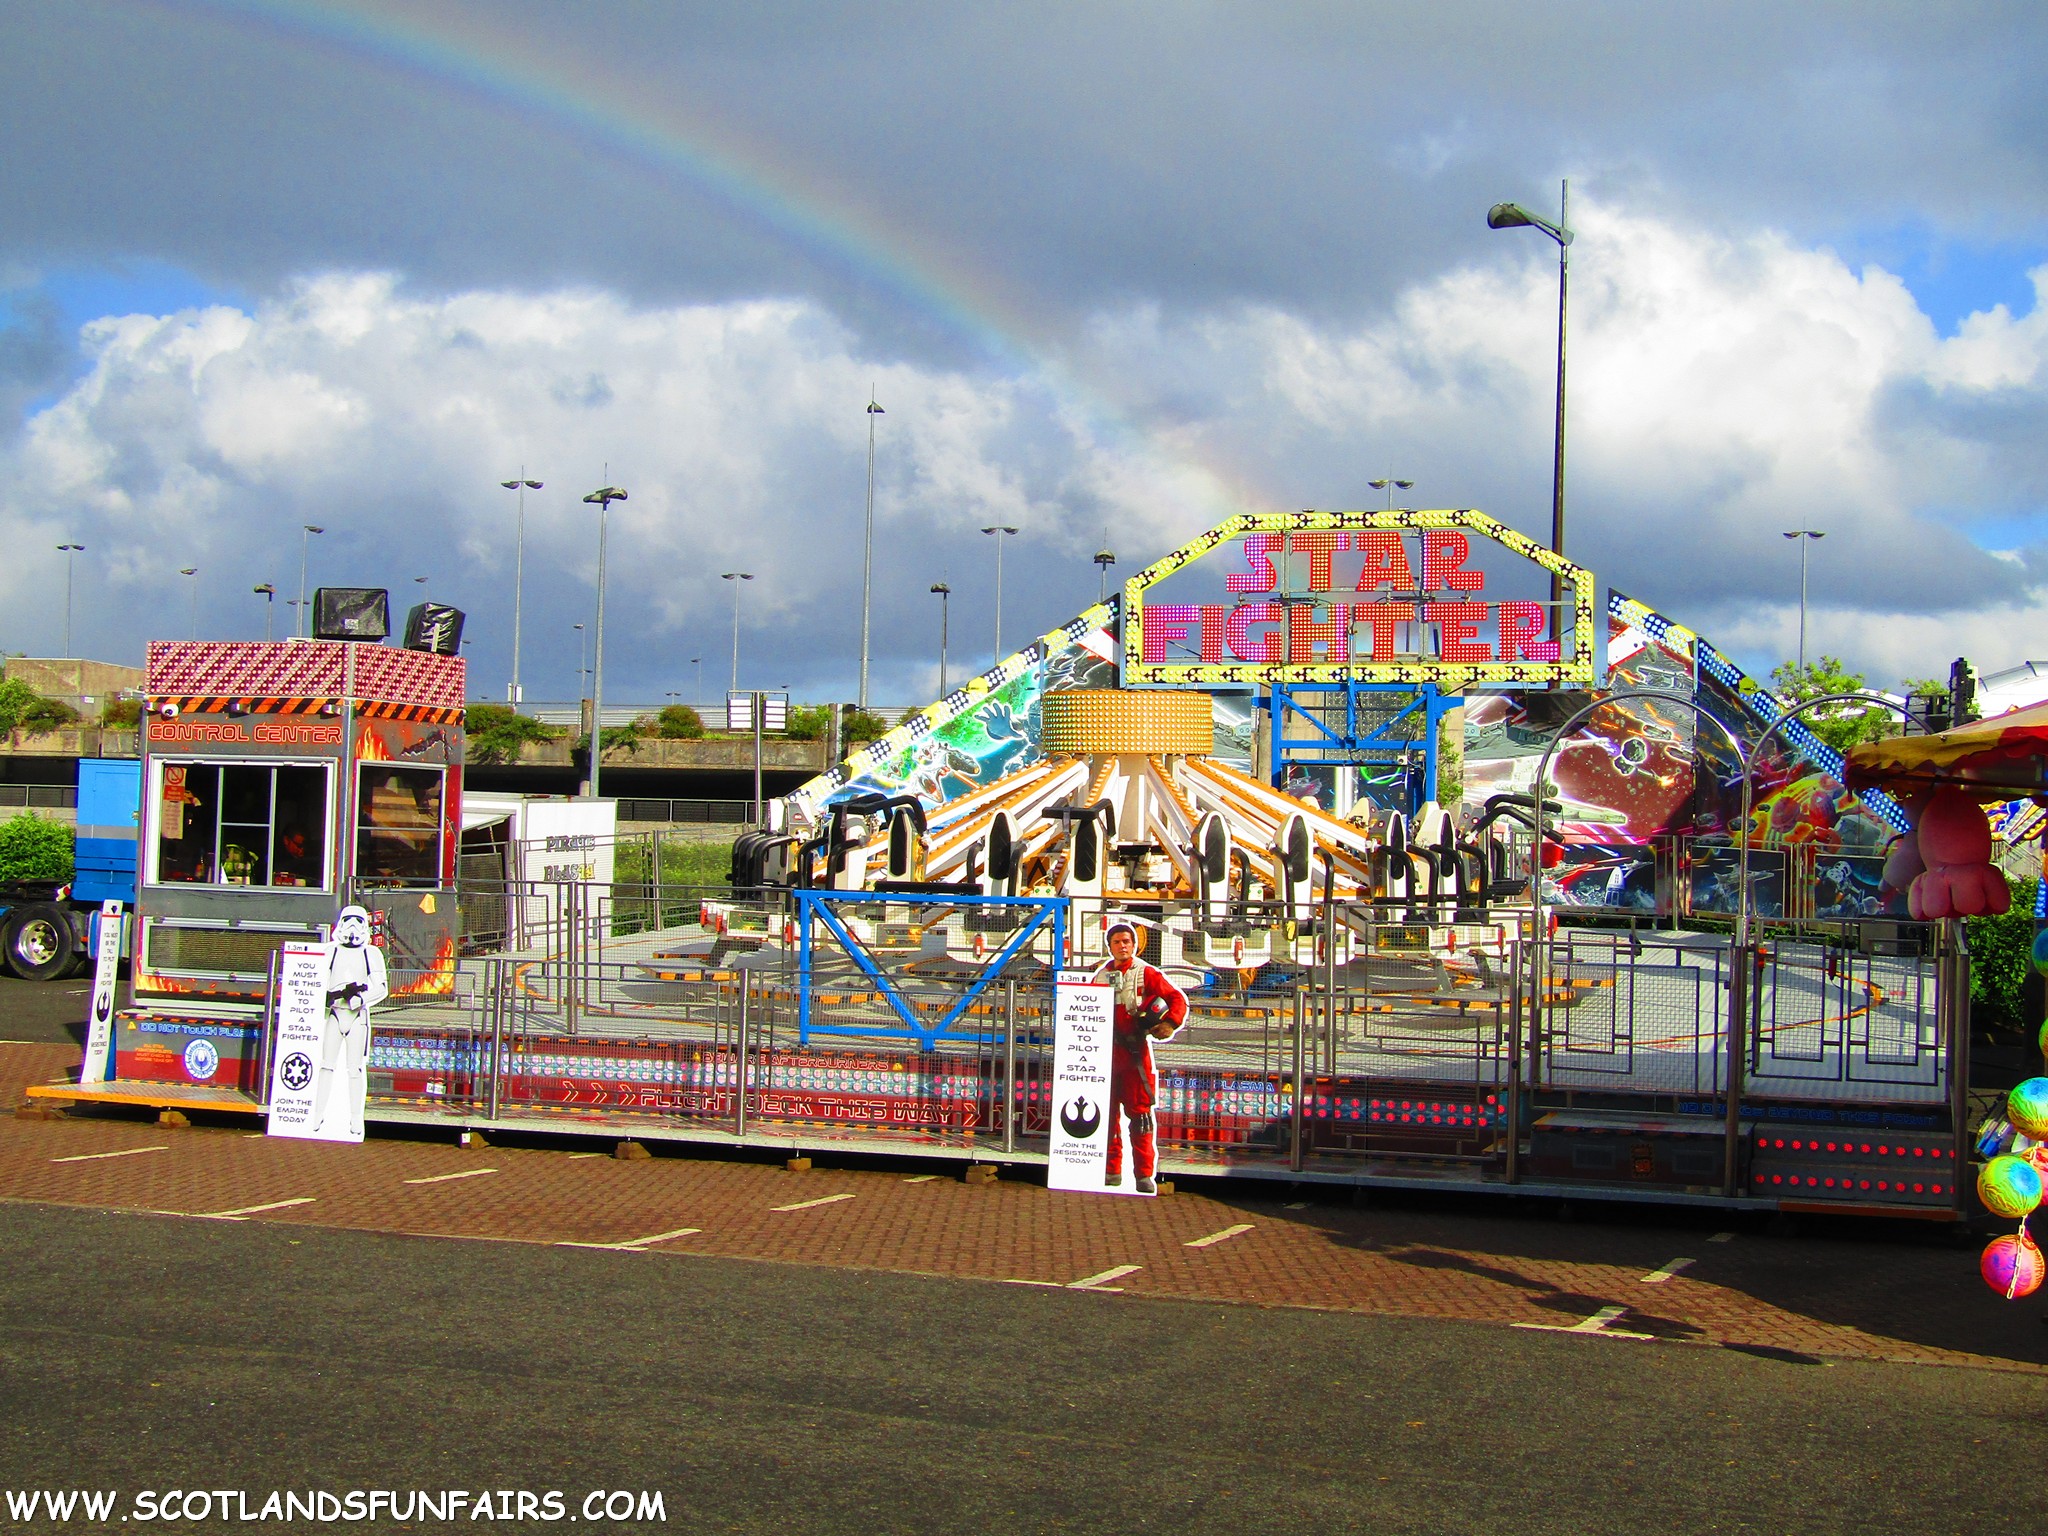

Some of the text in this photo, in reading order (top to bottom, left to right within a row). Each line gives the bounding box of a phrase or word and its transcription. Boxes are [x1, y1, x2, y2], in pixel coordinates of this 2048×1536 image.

[1226, 531, 1484, 592] STAR
[1142, 600, 1560, 663] FIGHTER
[149, 724, 342, 744] CONTROL CENTER
[140, 1022, 157, 1032] DO
[158, 1023, 181, 1034] NOT
[183, 1024, 217, 1036] TOUCH
[374, 1037, 391, 1046] DO
[392, 1037, 416, 1047] NOT
[417, 1038, 457, 1050] TOUCH
[771, 1052, 888, 1071] AFTERBURNERS
[1059, 1074, 1106, 1082] FIGHTER
[1213, 1079, 1275, 1092] PLASMA
[276, 1107, 309, 1115] EMPIRE
[641, 1088, 737, 1111] FLIGHT
[818, 1097, 887, 1120] THIS
[893, 1101, 953, 1124] WAY
[278, 1115, 306, 1123] TODAY
[1768, 1106, 1834, 1122] BEYOND
[1839, 1110, 1880, 1124] THIS
[1053, 1149, 1104, 1157] RESISTANCE
